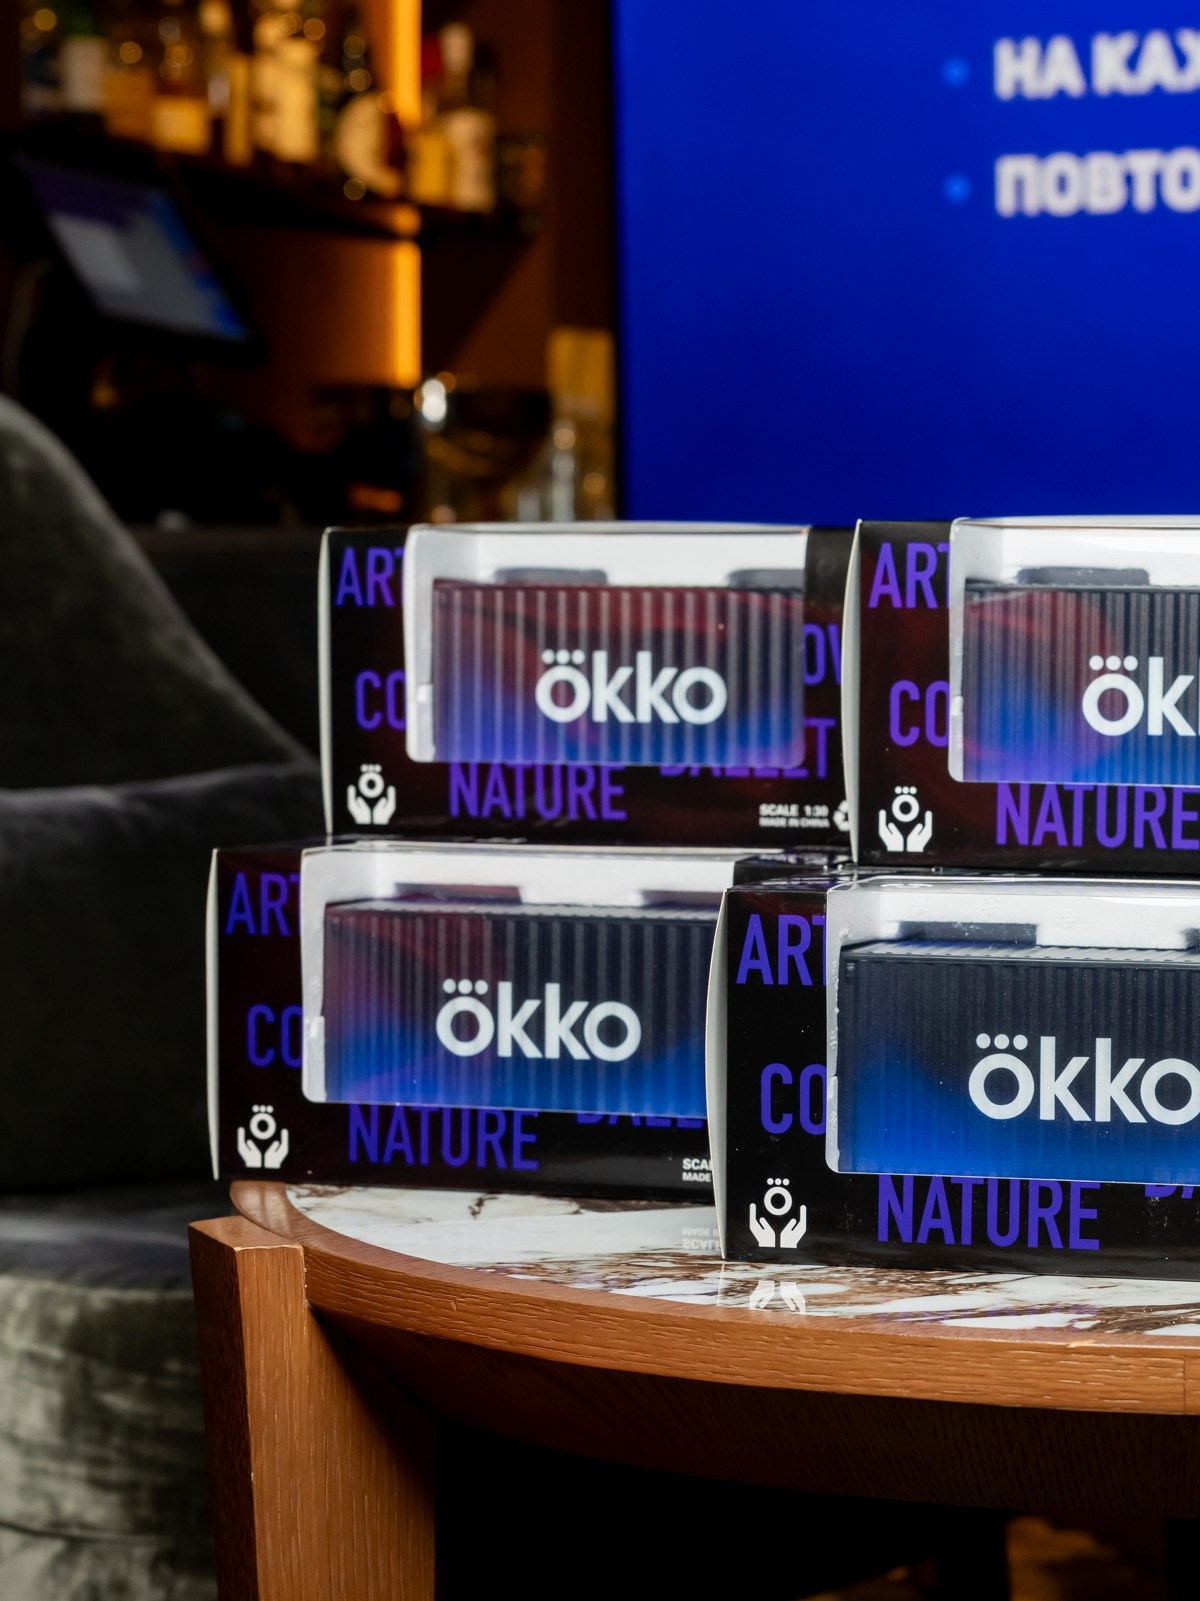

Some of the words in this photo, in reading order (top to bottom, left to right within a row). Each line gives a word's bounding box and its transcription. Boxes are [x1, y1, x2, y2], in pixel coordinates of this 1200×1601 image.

[995, 35, 1086, 99] НА
[449, 763, 627, 822] NATURE
[996, 782, 1200, 850] NATURE
[347, 1103, 540, 1171] NATURE
[682, 1171, 711, 1182] MADE
[877, 1173, 1101, 1251] NATURE
